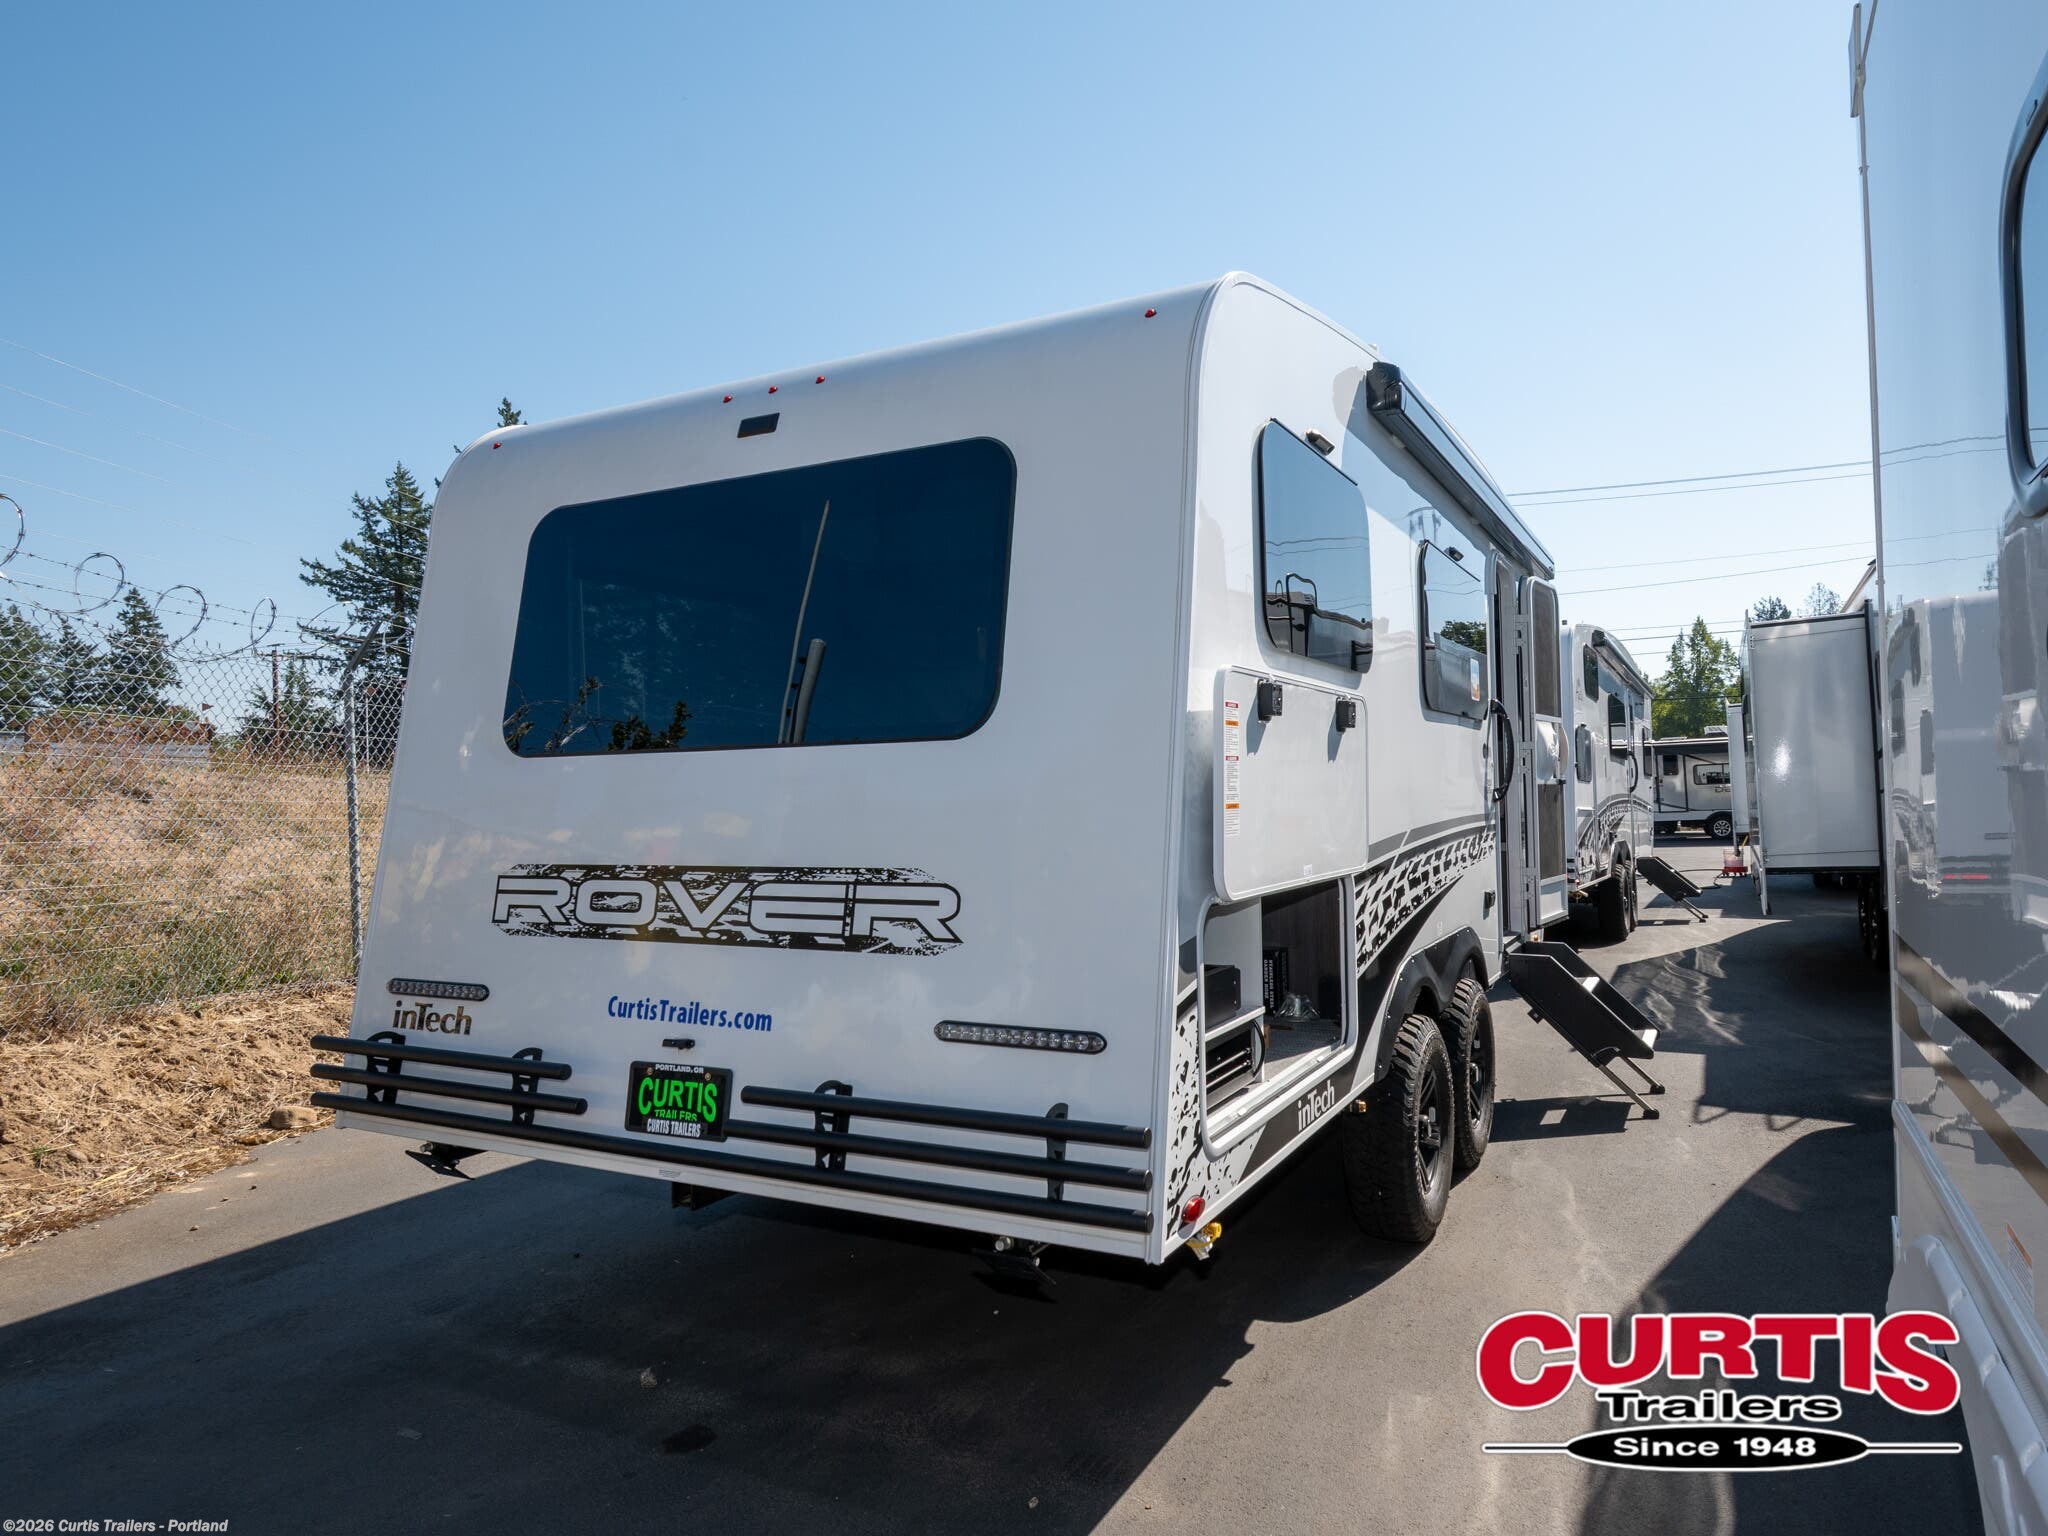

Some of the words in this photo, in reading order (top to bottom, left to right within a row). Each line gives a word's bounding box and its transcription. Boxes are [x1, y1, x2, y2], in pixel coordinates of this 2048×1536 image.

[492, 874, 964, 943] ROVER
[392, 1000, 472, 1035] inTech
[607, 995, 773, 1032] CurtisTrailers.com
[638, 1077, 718, 1123] CURTIS
[1297, 1079, 1335, 1132] inTech
[646, 1118, 670, 1135] CURTIS
[671, 1120, 701, 1138] TRAILERS
